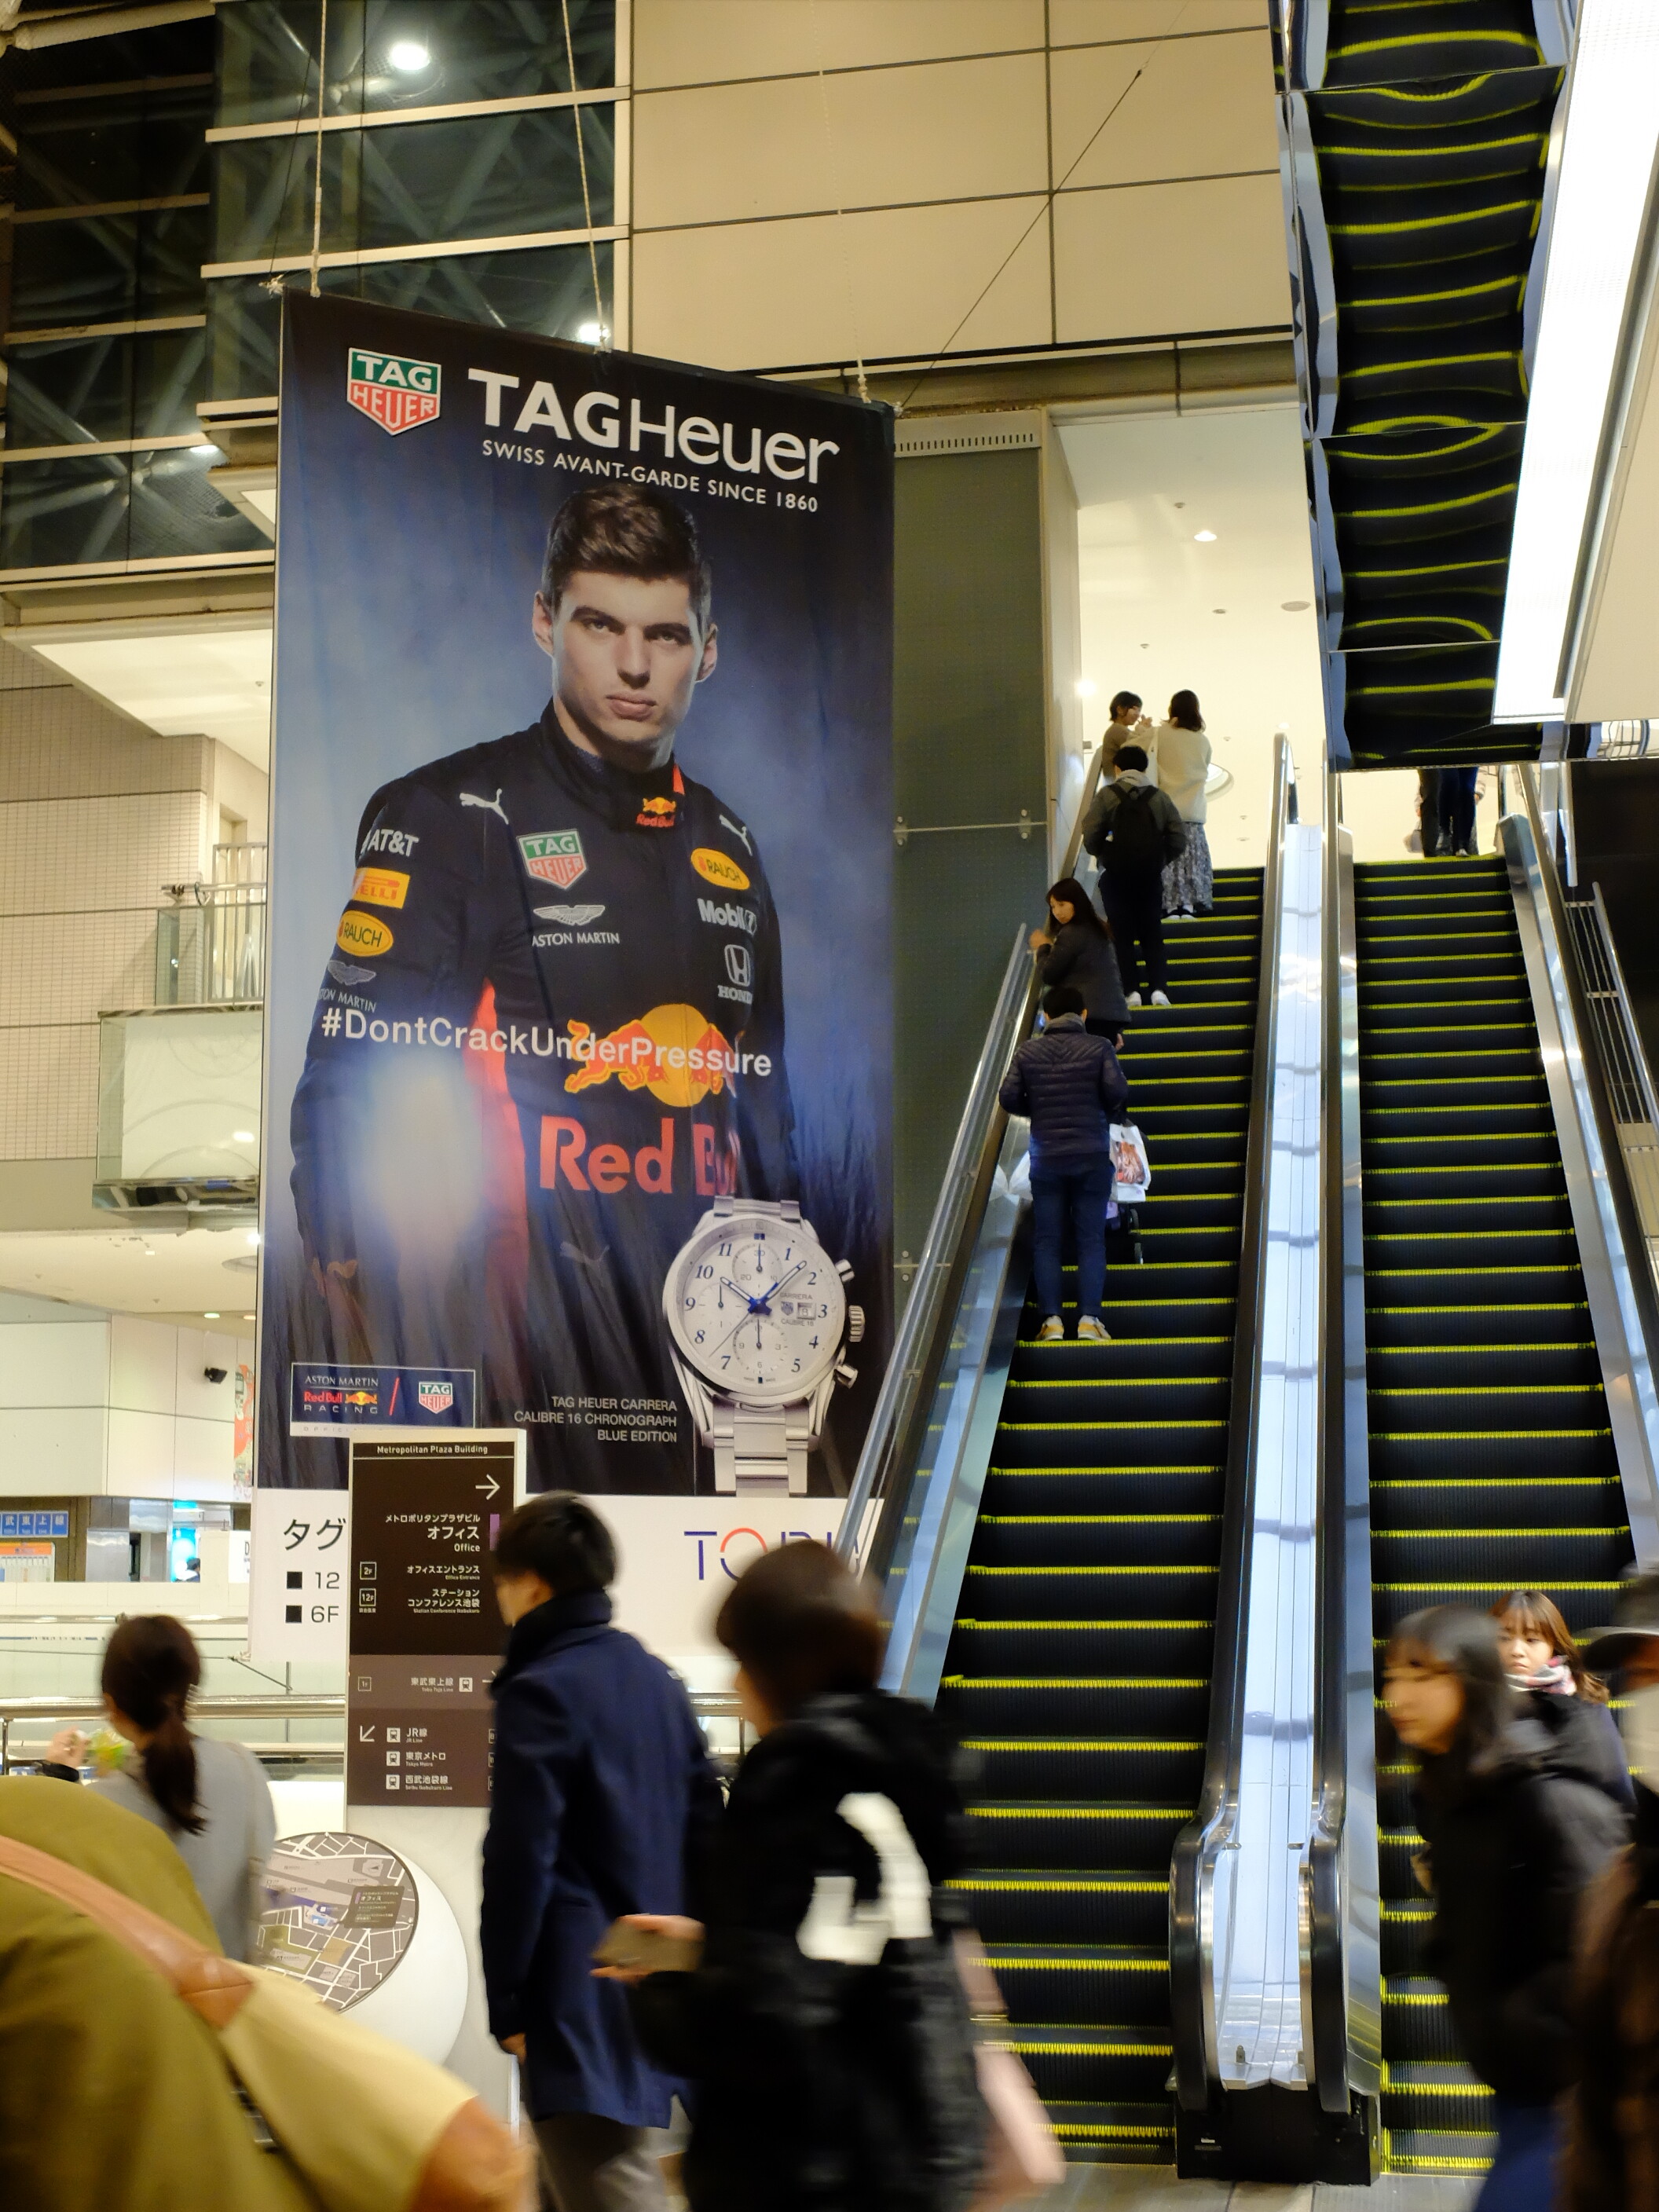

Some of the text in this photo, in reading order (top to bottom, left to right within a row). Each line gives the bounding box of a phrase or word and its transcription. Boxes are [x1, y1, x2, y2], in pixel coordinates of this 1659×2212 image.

[356, 354, 432, 392] TAG
[353, 384, 434, 429] HEUER
[482, 439, 818, 512] SWISS AVANT-GARDE SINCE 1860
[367, 828, 419, 857] AT&T
[526, 836, 576, 856] TAG
[531, 855, 582, 885] HEUER
[705, 859, 742, 884] RAUCH
[697, 898, 745, 930] Mobil
[342, 921, 383, 948] RAUCH
[532, 932, 621, 947] ASTON MARTIN
[338, 991, 377, 1013] MARTIN
[321, 1007, 772, 1077] #DontCrackUnderPressure
[540, 1115, 675, 1195] Red
[695, 1265, 714, 1280] 10
[808, 1272, 817, 1286] 2
[684, 1297, 696, 1312] 9
[818, 1304, 827, 1319] 3
[694, 1329, 705, 1345] 8
[808, 1335, 819, 1349] 4
[720, 1355, 731, 1370] 7
[791, 1358, 800, 1373] 5
[304, 1375, 379, 1387] ASTON MARTIN
[303, 1390, 342, 1404] Red Bull
[422, 1384, 451, 1395] TAG
[304, 1404, 378, 1415] RACING
[420, 1395, 452, 1411] HEUER
[551, 1395, 678, 1412] TAG HEUER CARRERA
[514, 1410, 677, 1427] CALIBRE 16 CHRONOGRAPH
[597, 1429, 677, 1443] BLUE EDITION
[377, 1445, 488, 1455] Metropolitan Plaza Building
[385, 1514, 481, 1523] メトロポリタンプラザビル
[284, 1518, 346, 1551] タグ
[427, 1525, 480, 1540] オフィス
[454, 1543, 481, 1552] Office
[364, 1566, 373, 1576] 2F
[407, 1565, 481, 1574] オフィスエントランス
[314, 1572, 340, 1590] 12
[432, 1588, 480, 1597] ステーション
[311, 1606, 339, 1623] 6F
[405, 1751, 446, 1761] 東京メトロ
